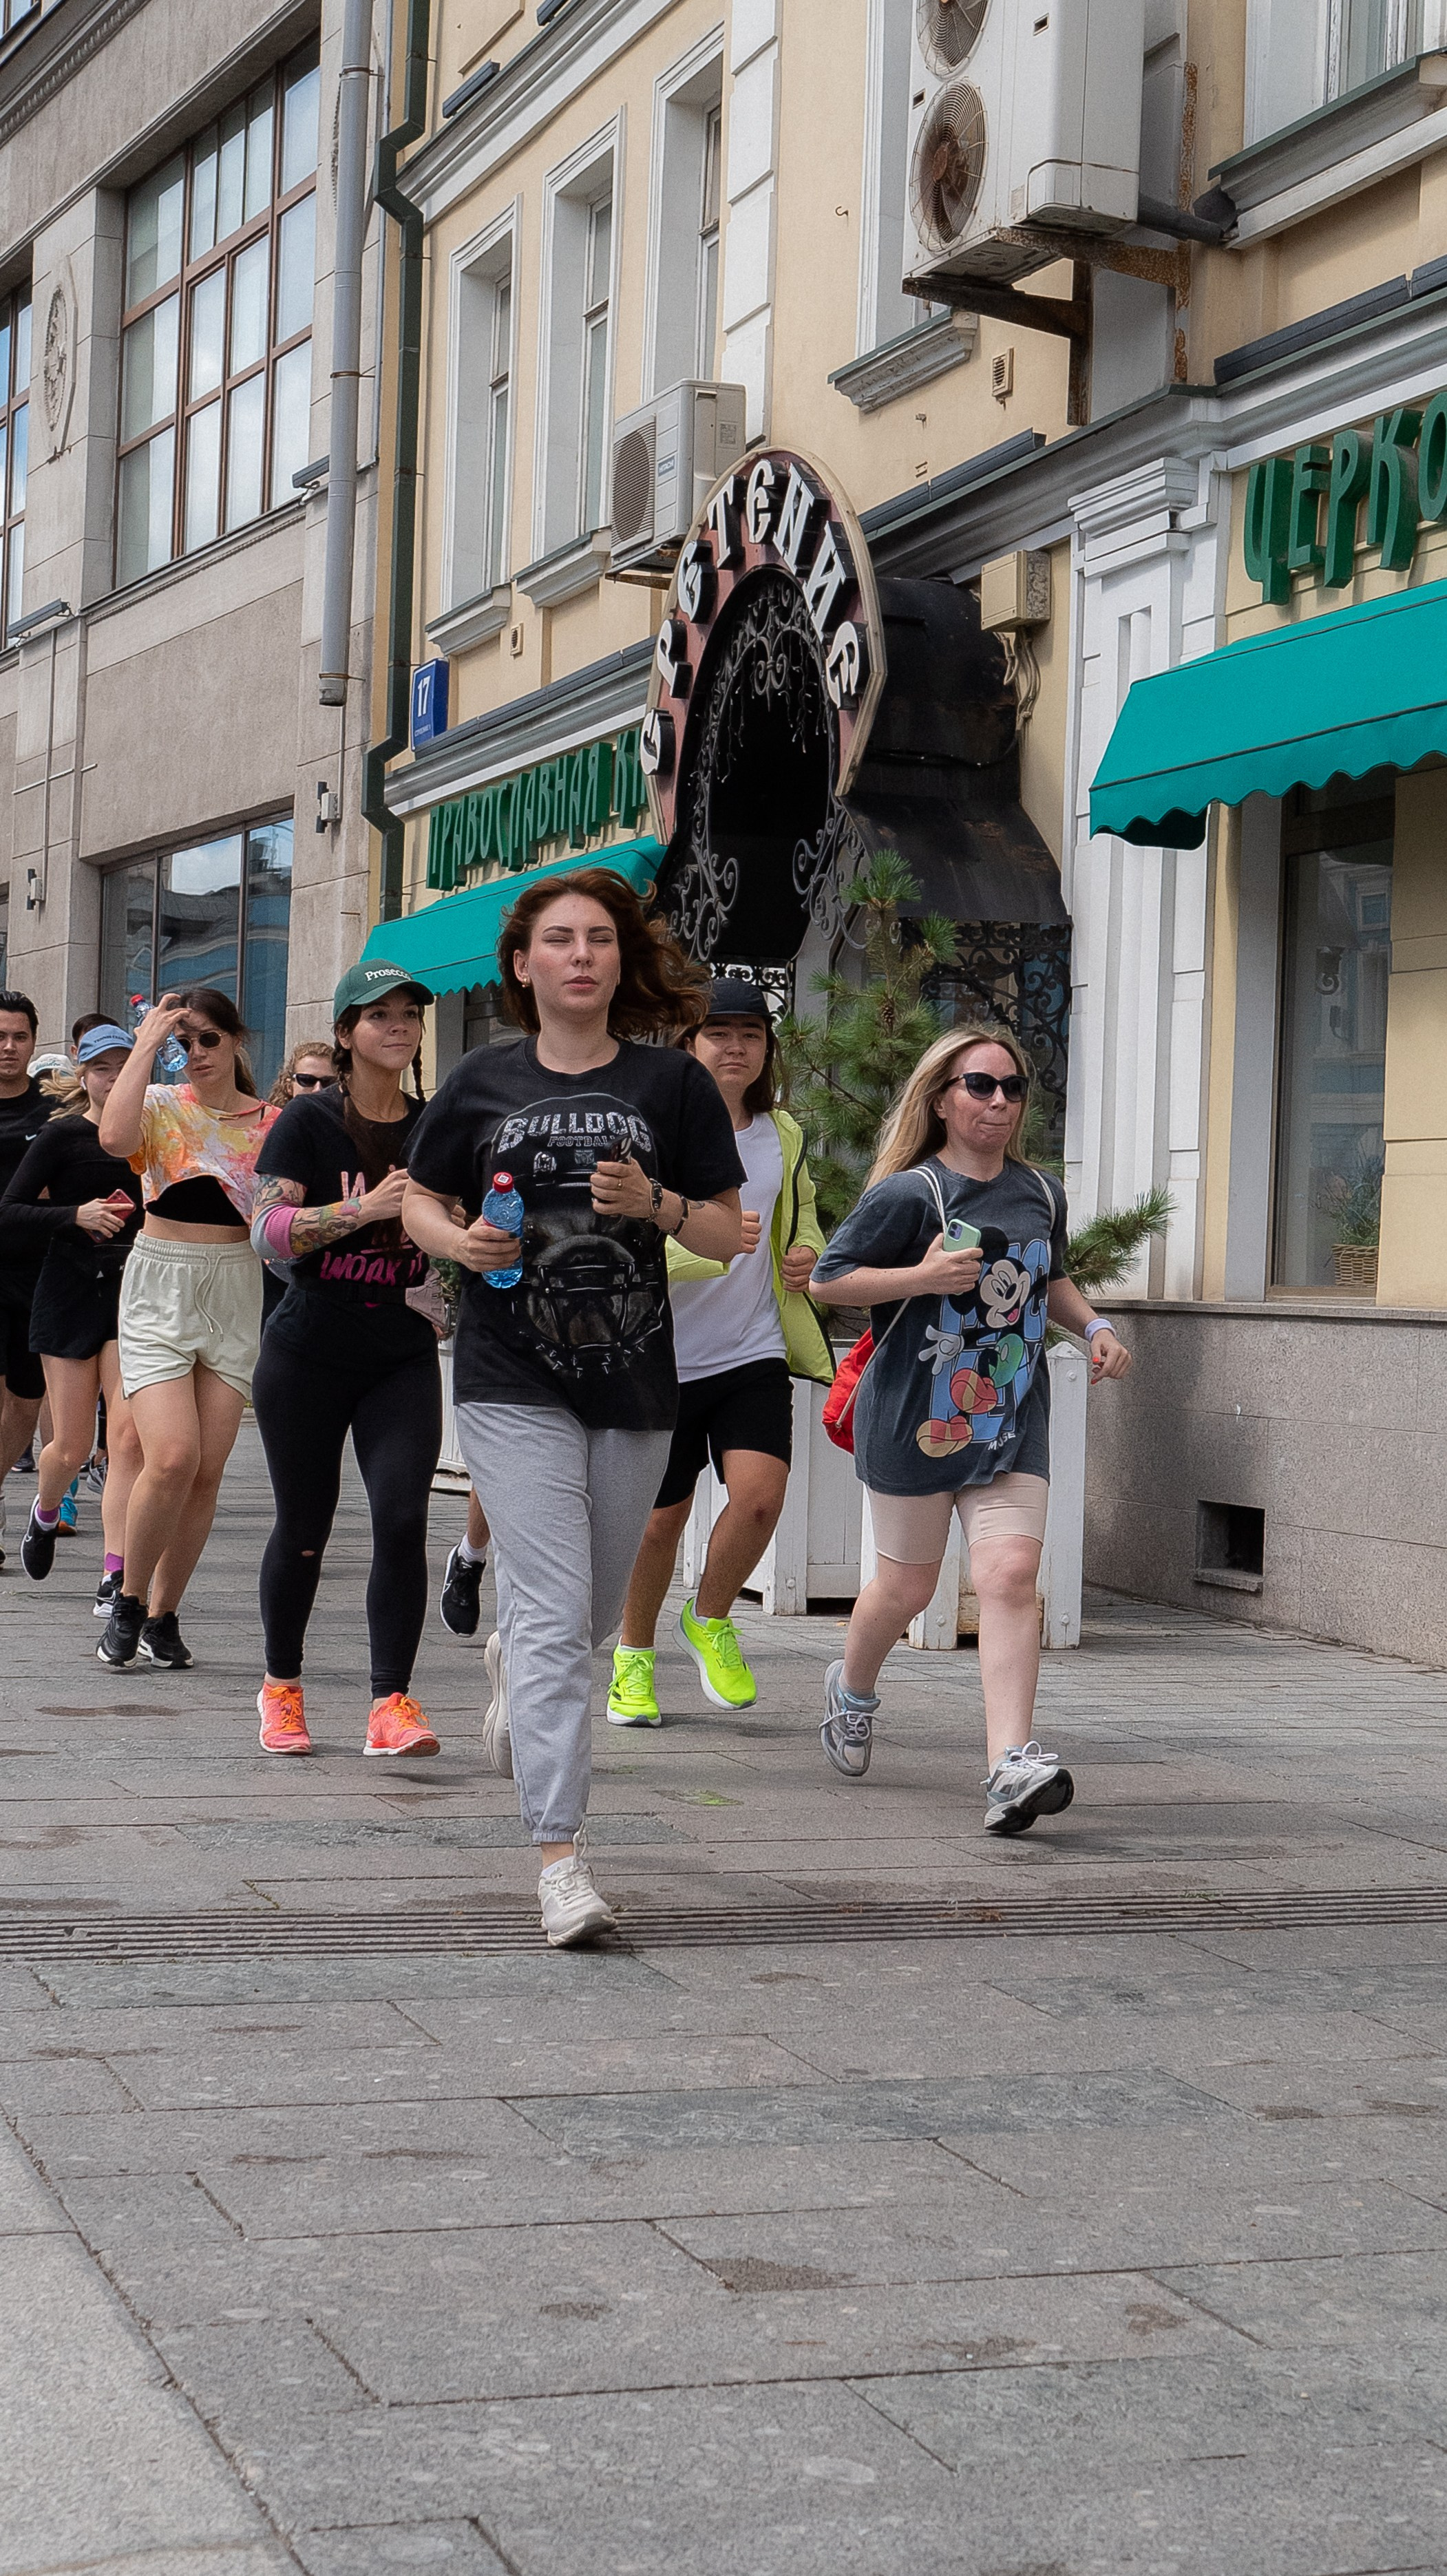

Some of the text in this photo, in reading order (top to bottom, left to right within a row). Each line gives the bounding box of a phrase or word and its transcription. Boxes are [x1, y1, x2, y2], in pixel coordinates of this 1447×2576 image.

[417, 675, 431, 717] 17
[426, 742, 612, 890] ПРАВОСЛАВНАЯ
[497, 1112, 652, 1154] BULLDOG
